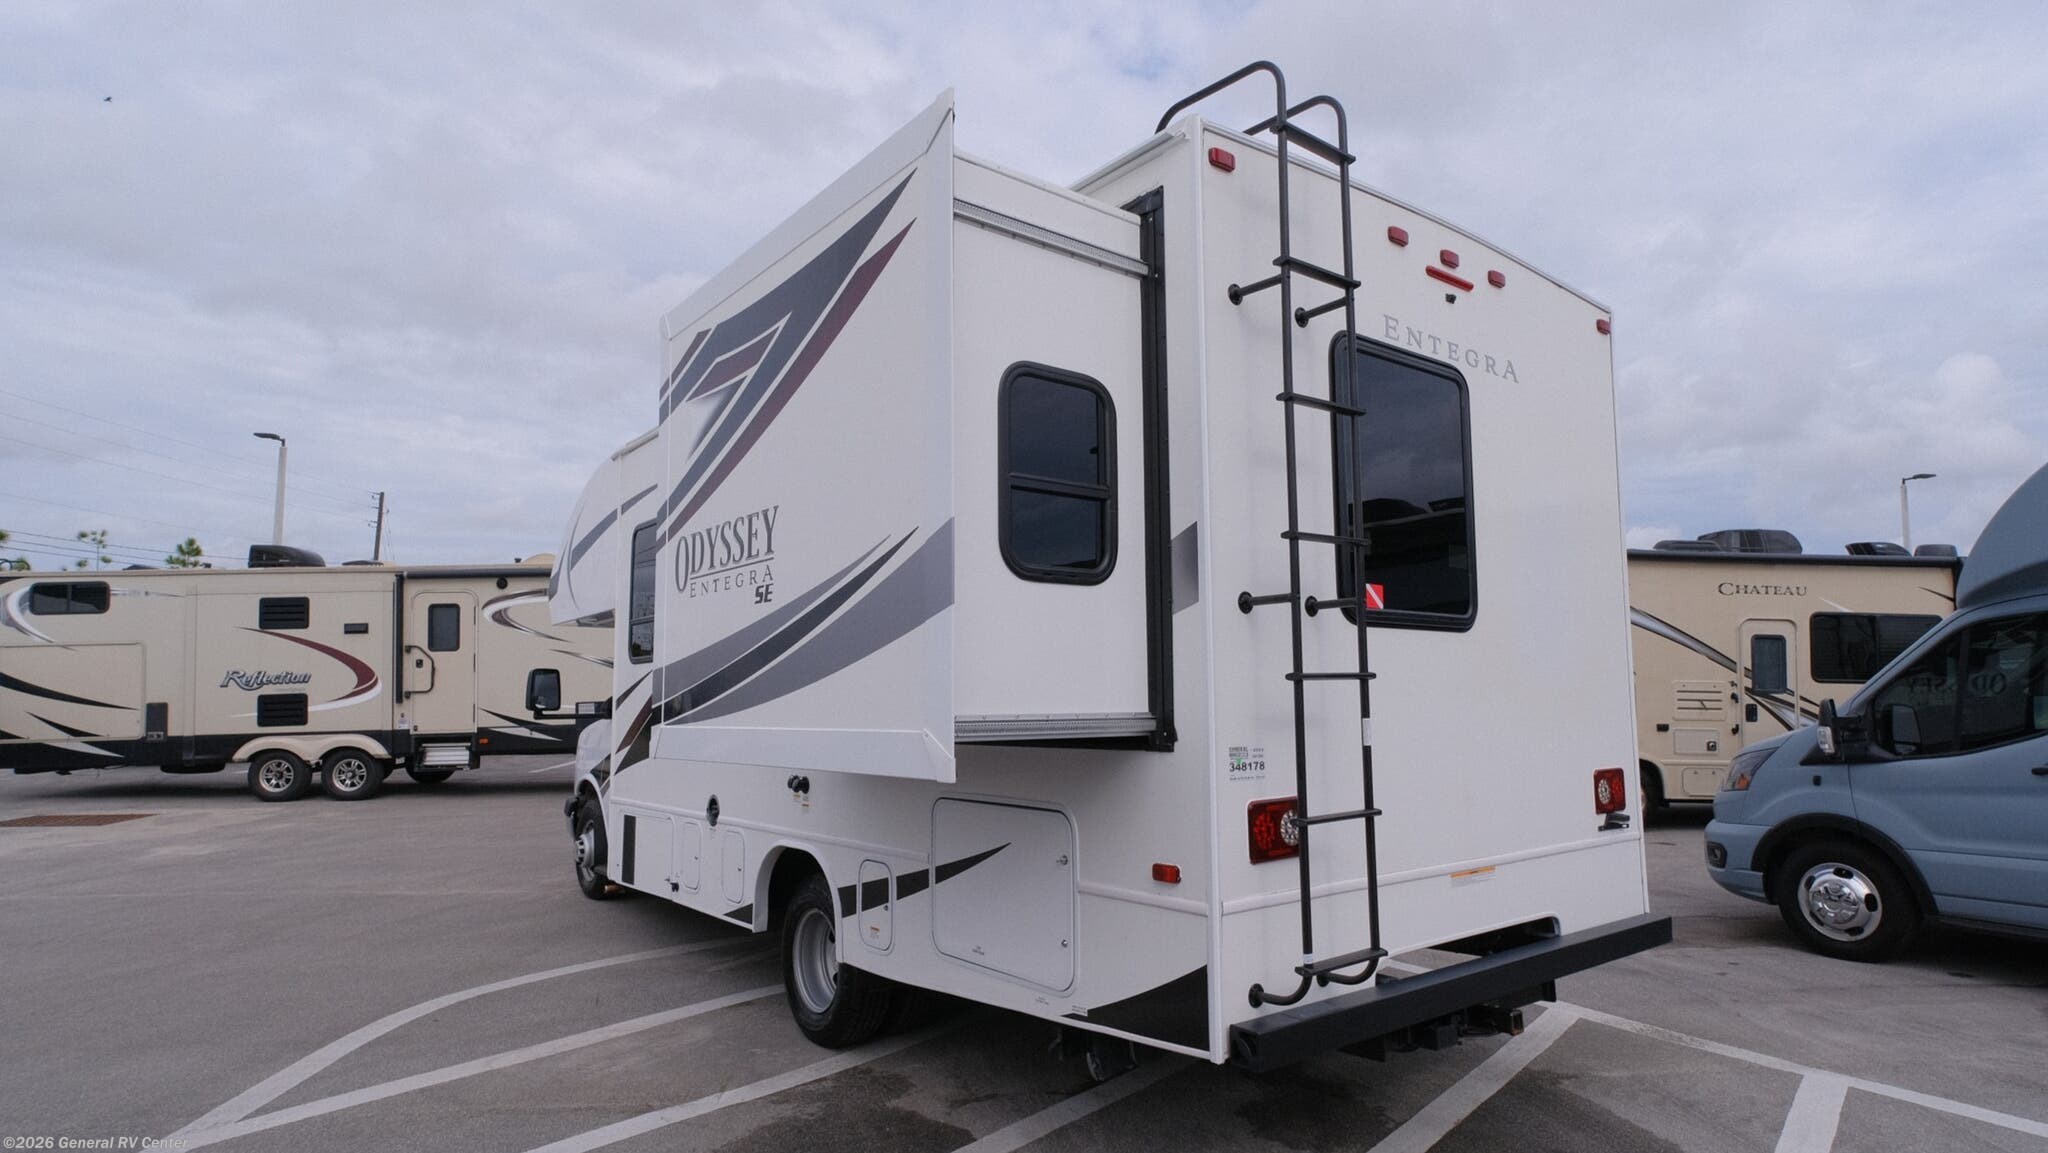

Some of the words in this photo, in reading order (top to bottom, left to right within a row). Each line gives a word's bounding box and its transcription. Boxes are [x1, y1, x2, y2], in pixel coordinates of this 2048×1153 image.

[1383, 314, 1519, 383] ENTEGRA
[674, 505, 779, 593] ODYSSEY
[689, 564, 774, 598] ENTEGRA
[1717, 581, 1808, 597] CHATEAU
[754, 583, 774, 604] SE
[219, 670, 312, 691] Reflection
[1229, 761, 1265, 772] 348178
